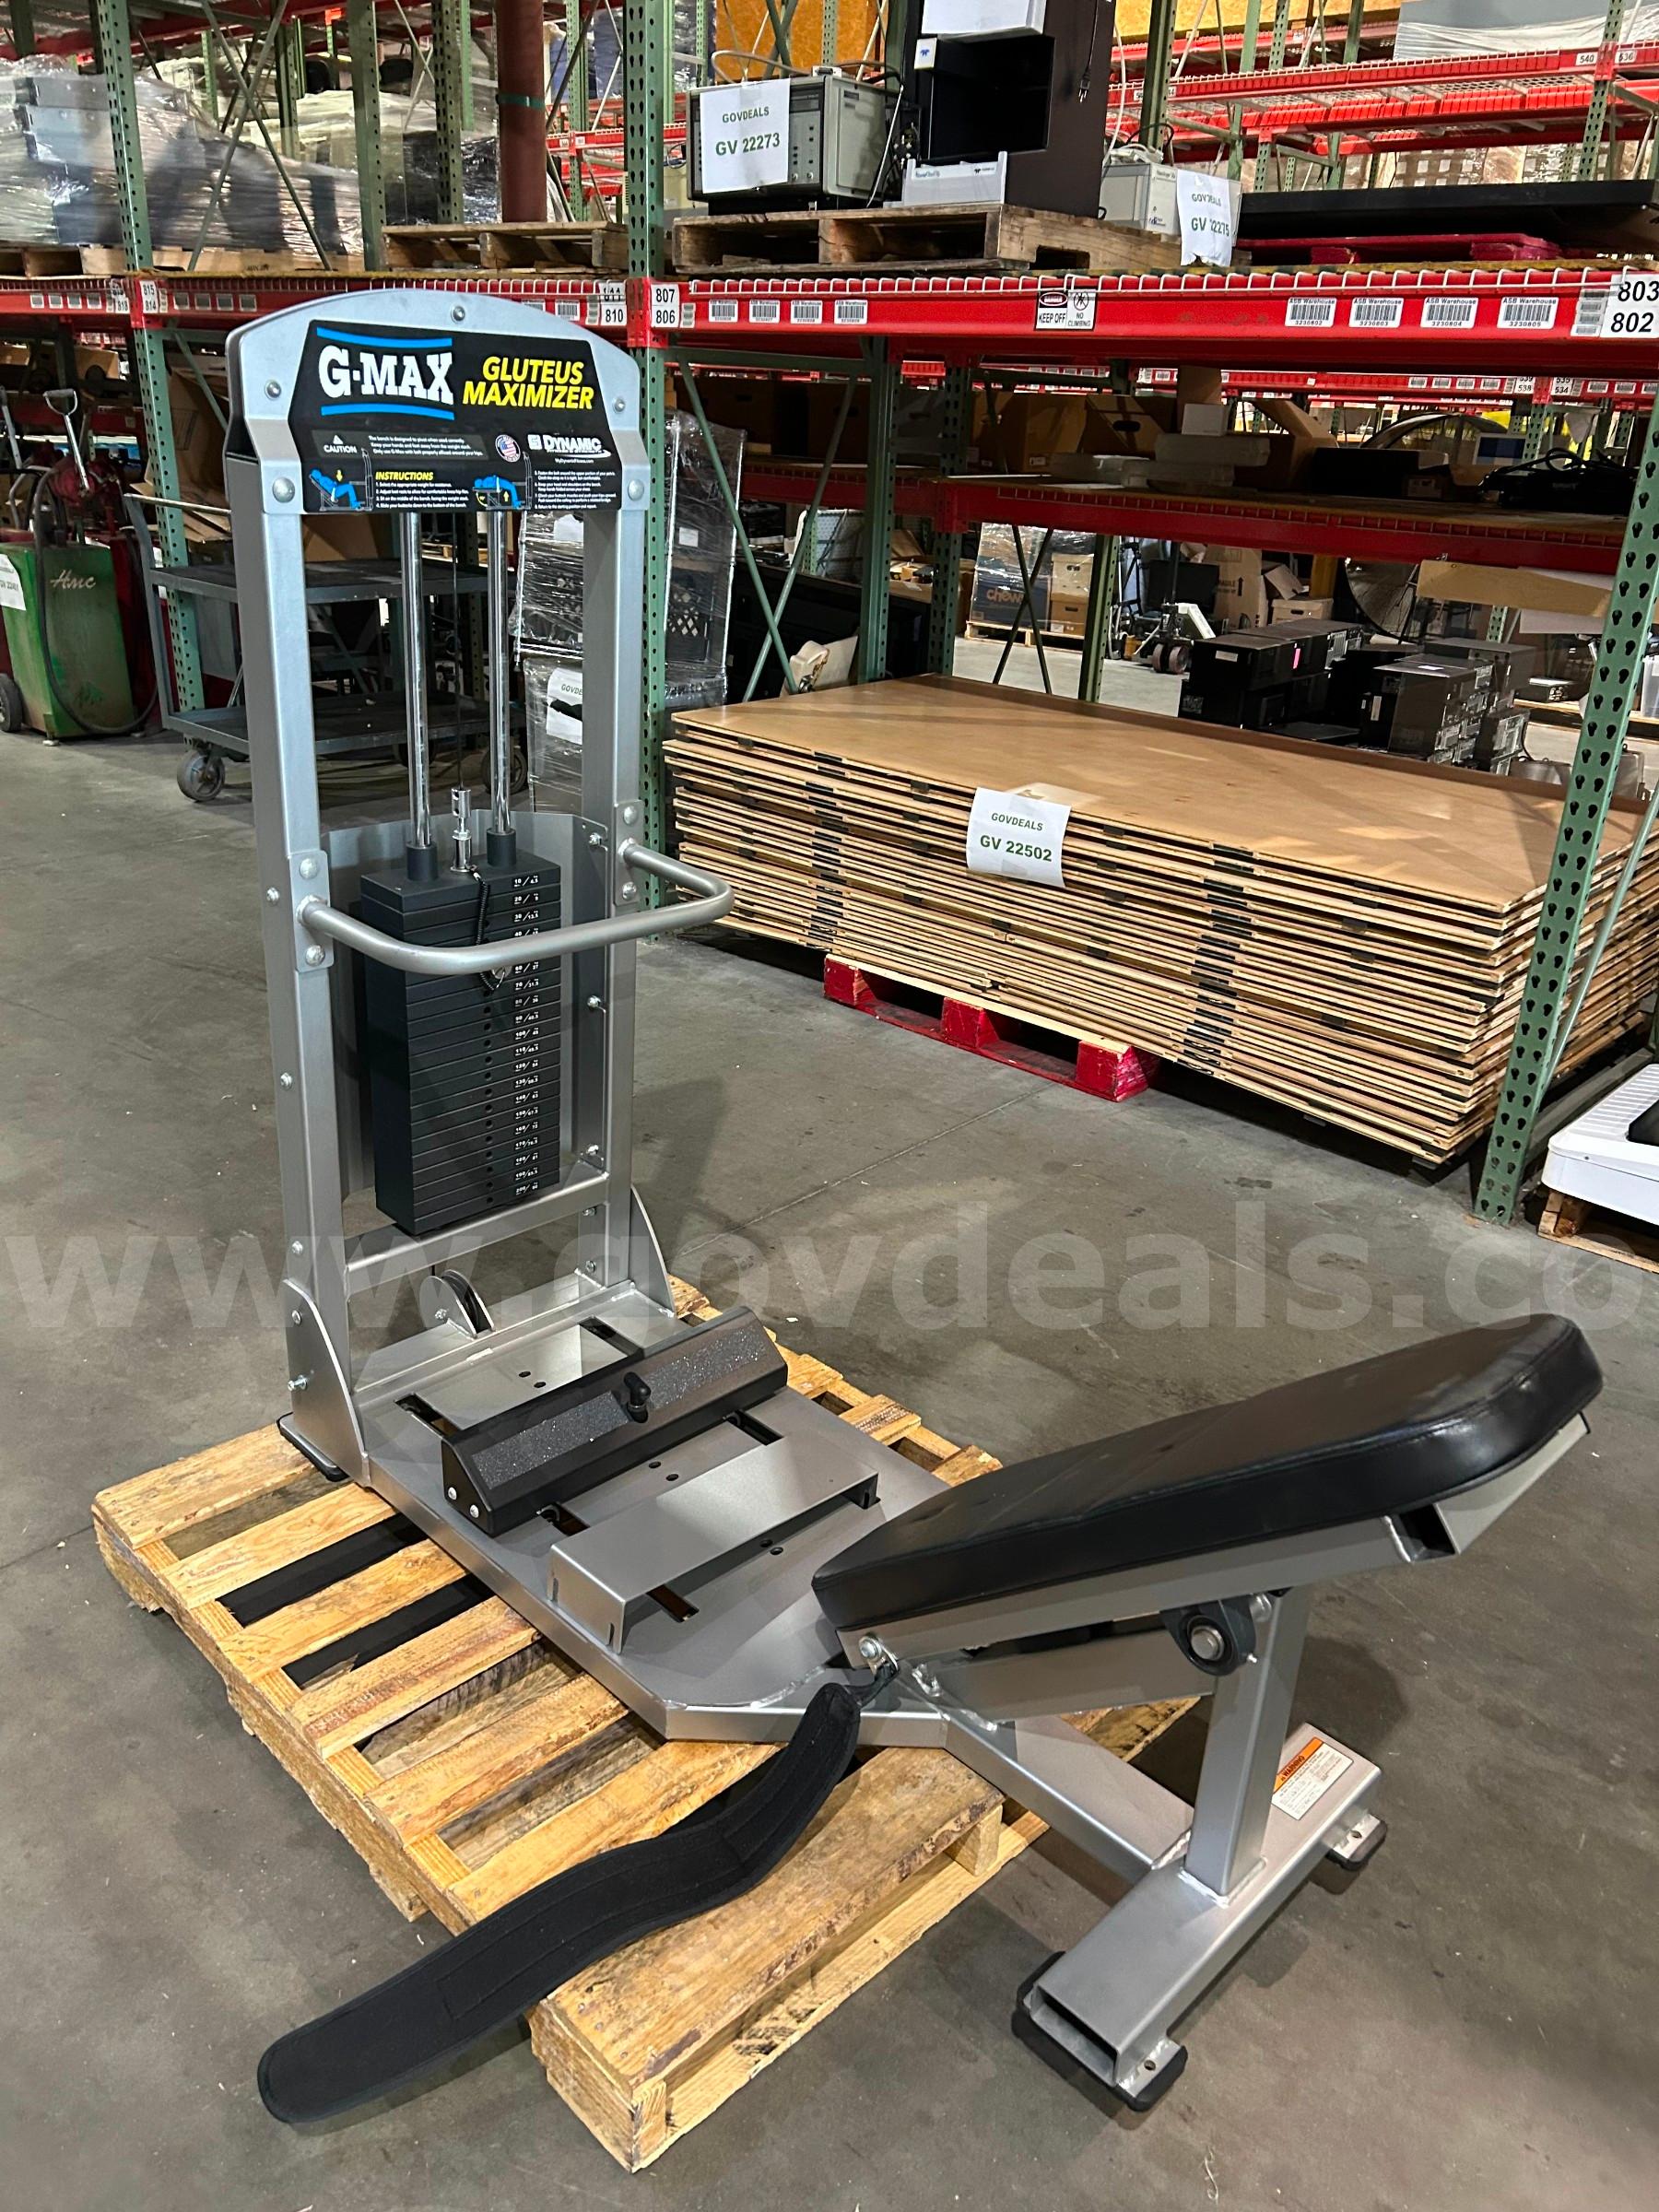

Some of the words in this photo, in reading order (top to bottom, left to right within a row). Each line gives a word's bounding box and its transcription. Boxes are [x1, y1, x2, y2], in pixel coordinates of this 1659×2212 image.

[722, 106, 770, 124] GOVDEALS
[715, 139, 738, 156] GV
[742, 132, 781, 154] 22273
[1191, 217, 1207, 231] GV
[142, 284, 155, 296] 815
[655, 288, 676, 303] 807
[1618, 280, 1659, 302] 803
[605, 309, 624, 323] 810
[655, 310, 676, 324] 806
[1039, 312, 1054, 324] KEEP
[1054, 312, 1066, 324] OFF
[1610, 312, 1654, 333] 802
[481, 356, 584, 386] GLUTEUS
[462, 380, 595, 410] MAXIMIZER
[324, 445, 358, 453] CAUTION
[542, 434, 602, 452] DYNAMIC
[375, 471, 433, 481] INSTRUCTIONS
[986, 589, 1025, 603] chew
[560, 683, 582, 696] GOVDE
[991, 812, 1043, 831] GOVDEALS
[980, 835, 1002, 850] GV
[1006, 840, 1053, 863] 22502
[1283, 1755, 1306, 1777] WARNING
